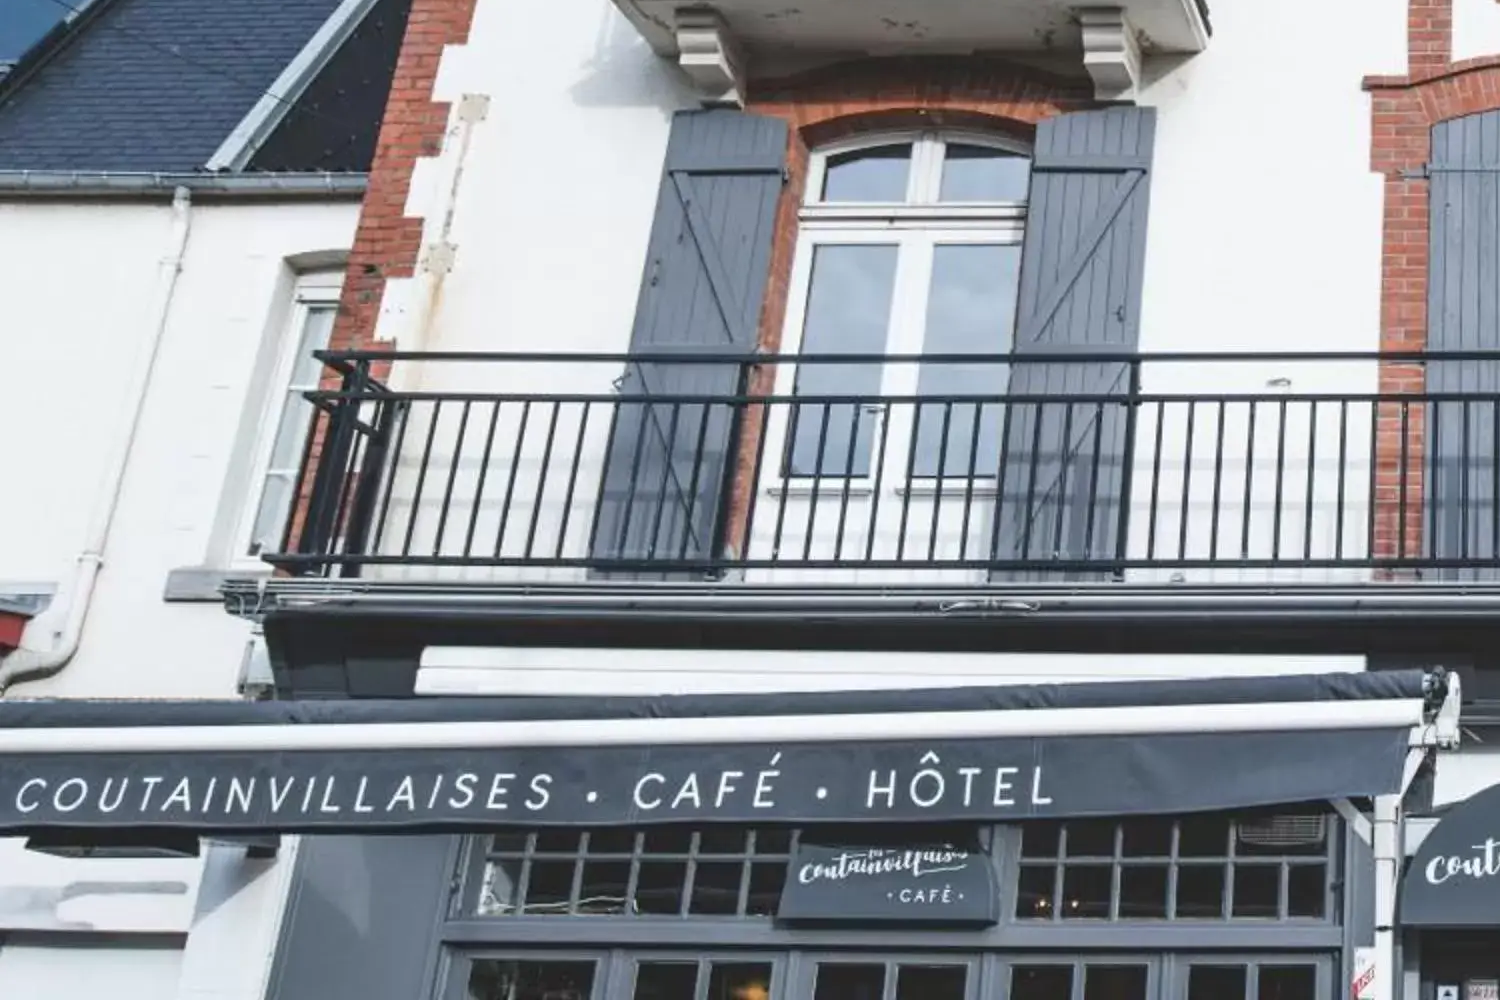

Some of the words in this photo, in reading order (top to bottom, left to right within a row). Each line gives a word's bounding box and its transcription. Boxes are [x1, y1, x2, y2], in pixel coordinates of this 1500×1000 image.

[15, 774, 553, 812] COUTAINVILLAISES
[634, 752, 781, 809] CAFÉ
[867, 751, 1053, 808] HÔTEL
[899, 884, 952, 904] CAFÉ
